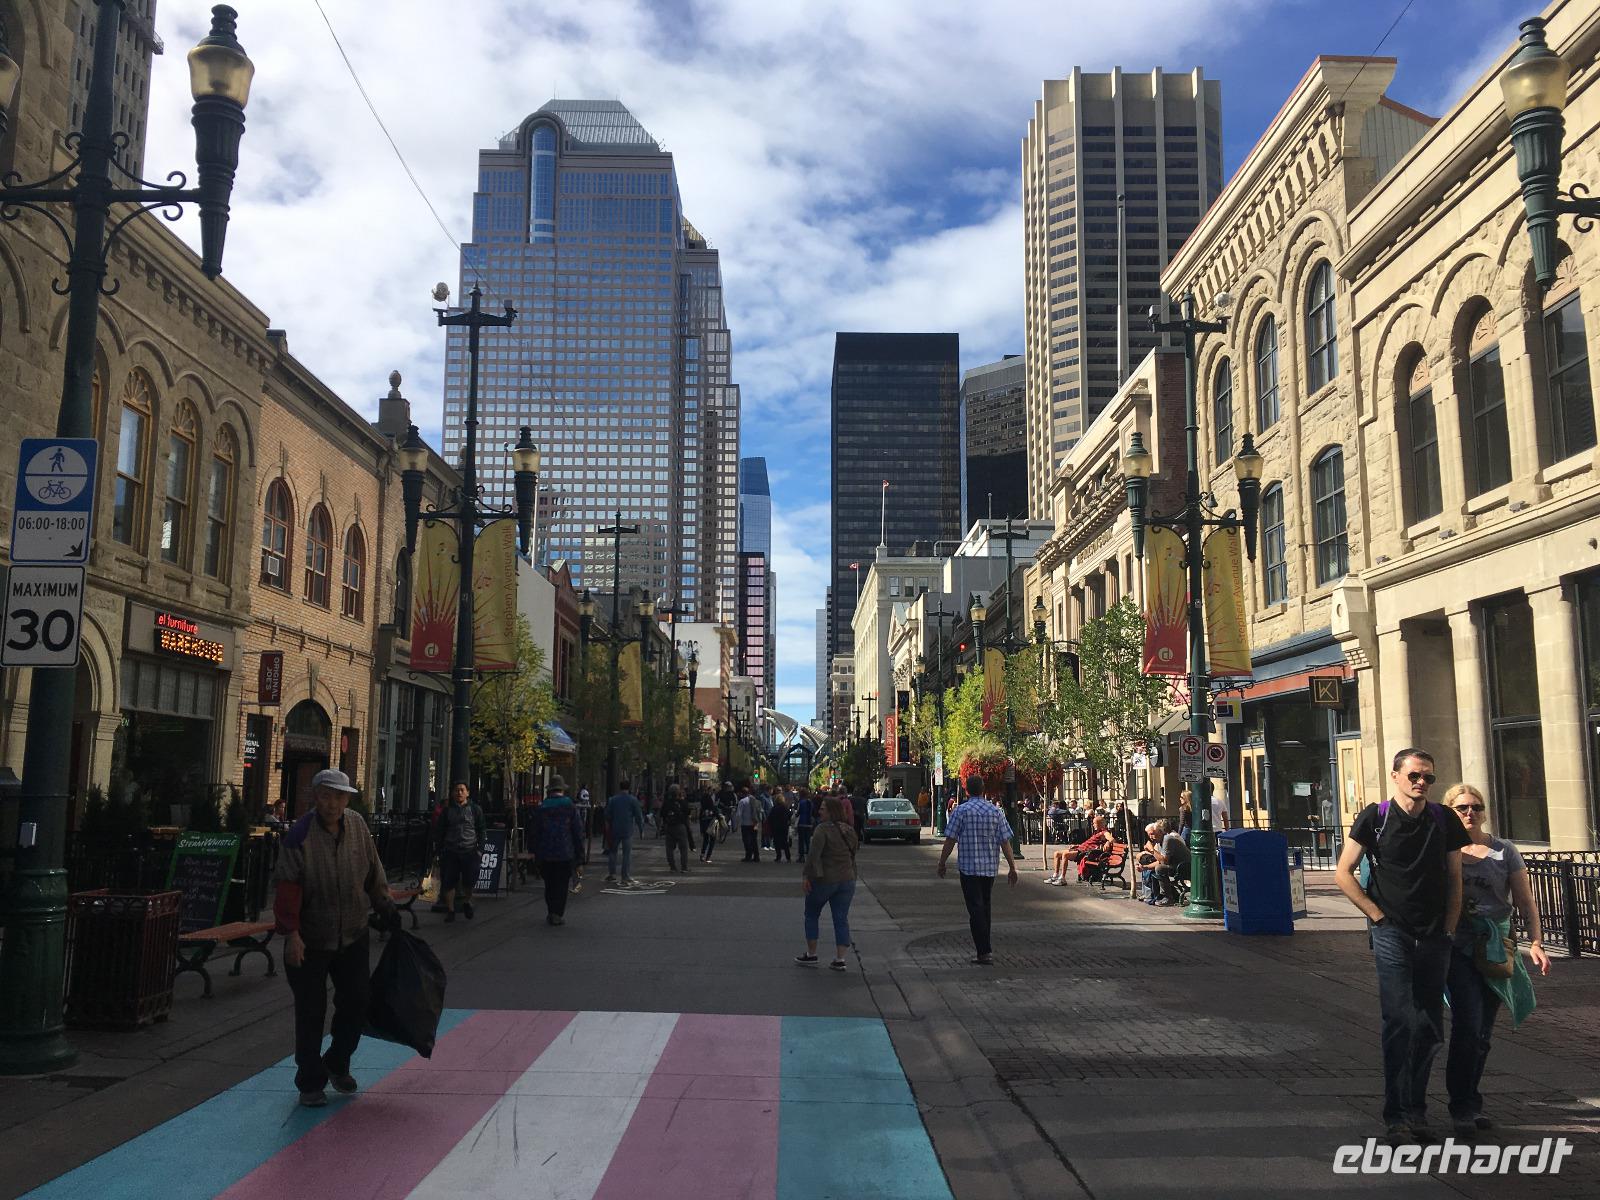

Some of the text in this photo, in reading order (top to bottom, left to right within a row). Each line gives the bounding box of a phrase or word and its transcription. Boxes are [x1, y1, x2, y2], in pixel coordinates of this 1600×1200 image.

[18, 516, 85, 530] 06:00-18:00
[12, 582, 78, 597] MAXIMUM
[504, 551, 513, 591] Avenue
[1232, 559, 1240, 596] Avenue
[6, 608, 75, 652] 30
[167, 613, 199, 635] furniture
[504, 593, 513, 638] Stephen
[271, 657, 280, 700] ORIGINAL
